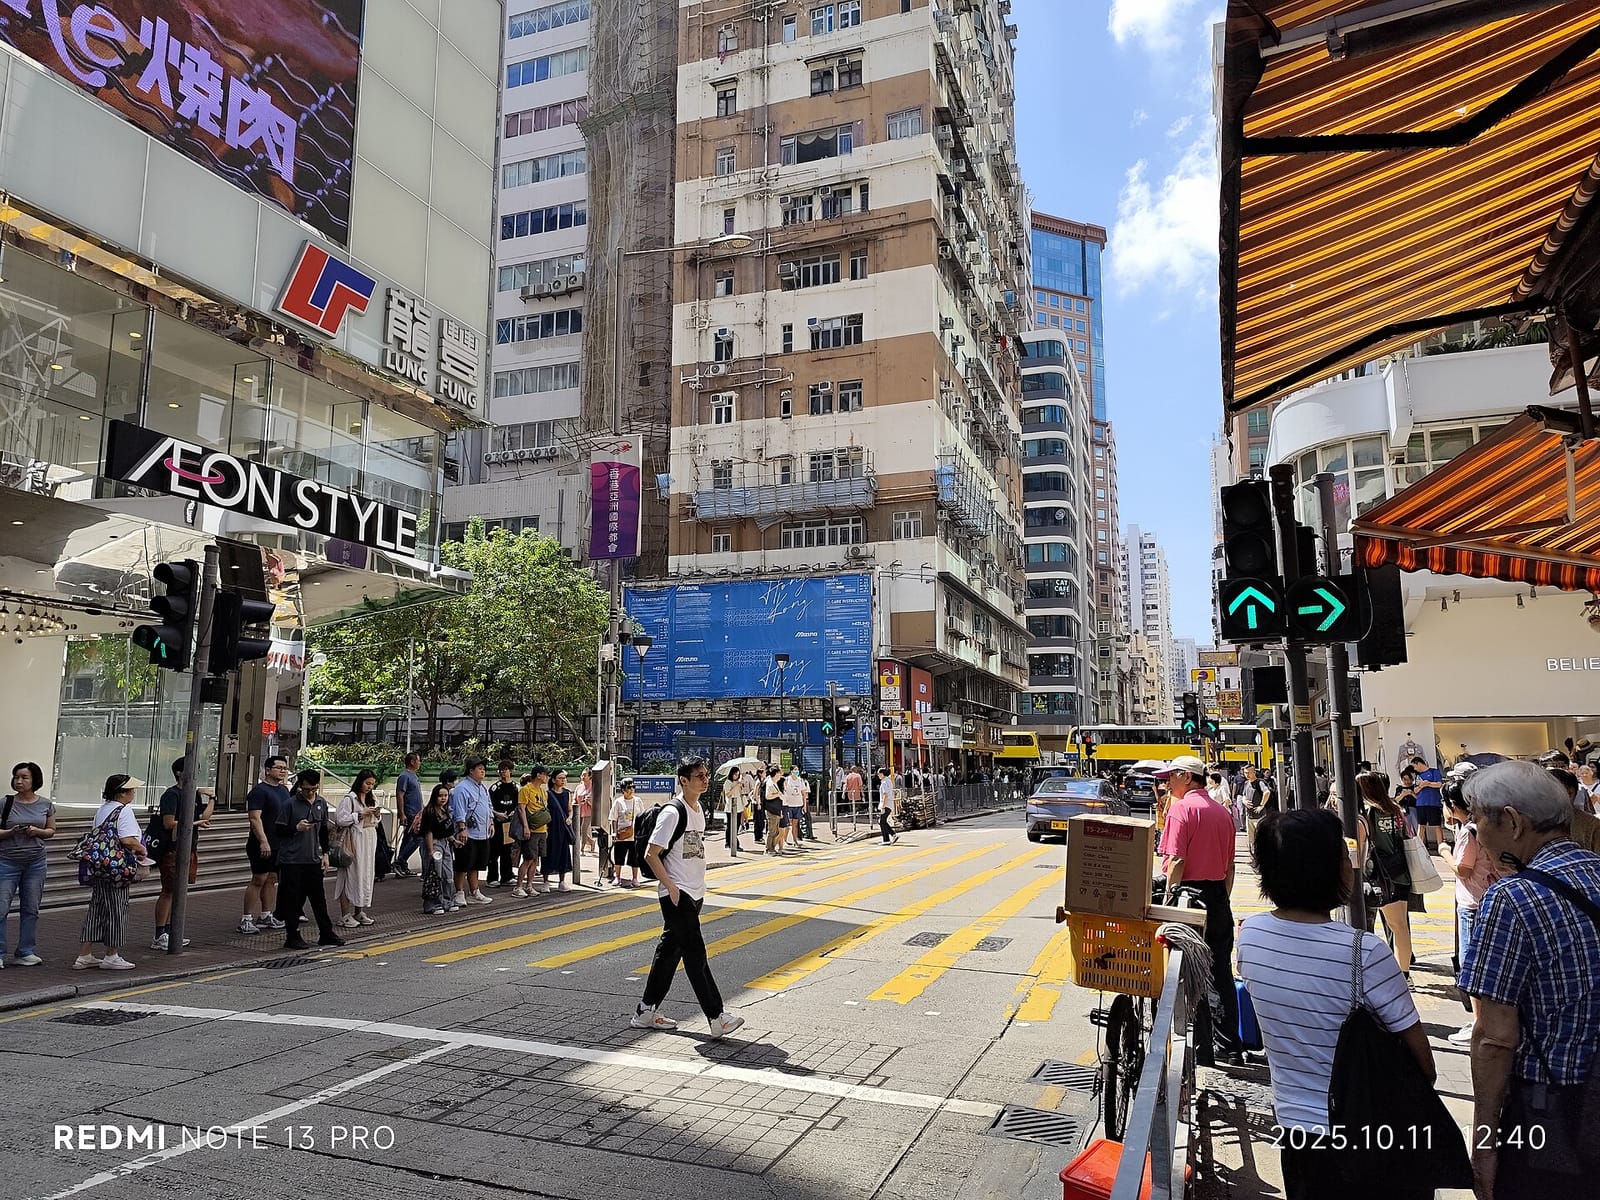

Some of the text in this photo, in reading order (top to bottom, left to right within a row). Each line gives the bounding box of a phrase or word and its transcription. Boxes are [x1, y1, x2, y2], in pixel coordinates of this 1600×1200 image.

[383, 348, 478, 409] LUNG FUNG
[293, 480, 416, 553] STYLE
[1547, 658, 1600, 671] BELIE
